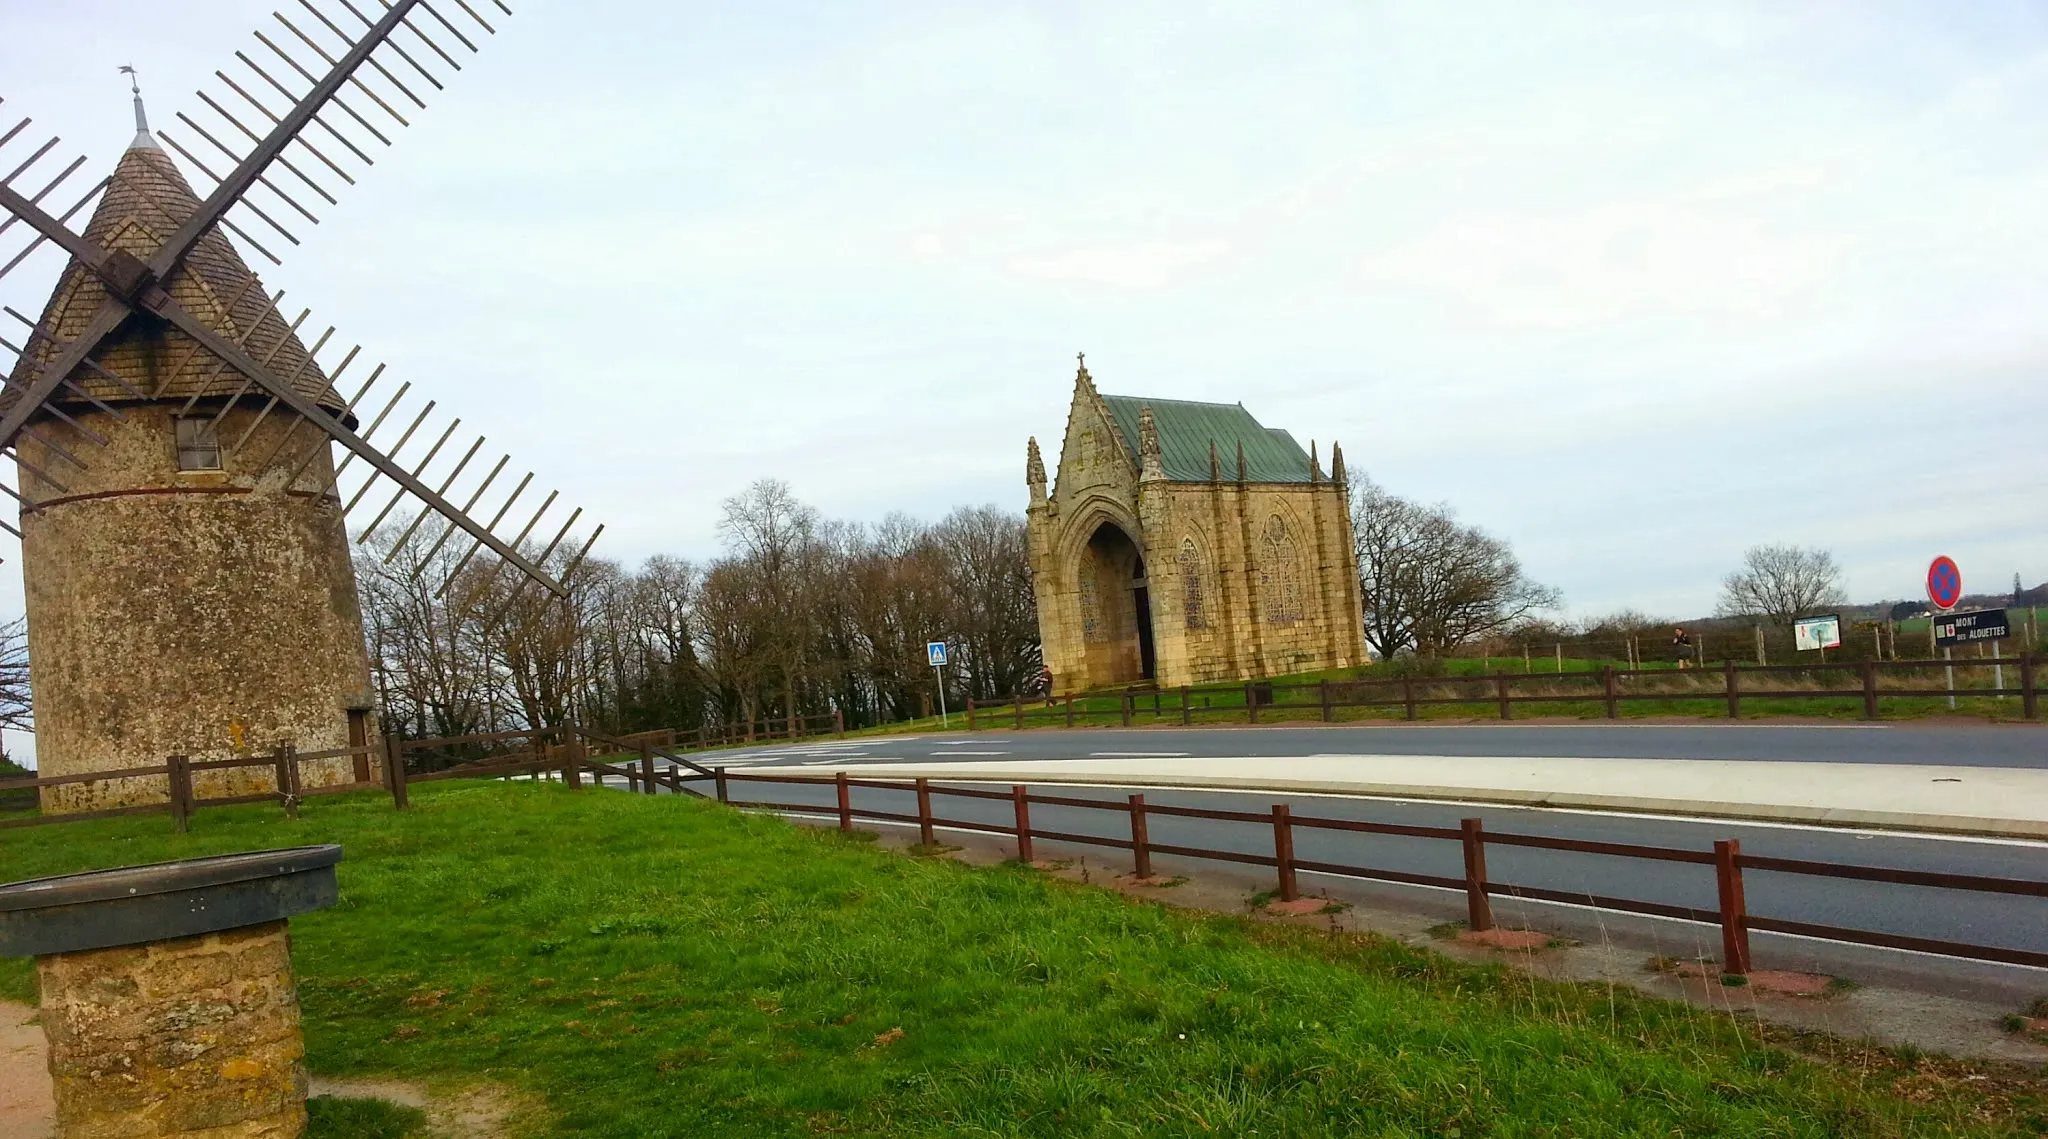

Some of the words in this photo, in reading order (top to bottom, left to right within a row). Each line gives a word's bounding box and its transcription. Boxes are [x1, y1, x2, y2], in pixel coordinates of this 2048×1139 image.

[1955, 616, 1977, 627] MONT
[1957, 633, 1966, 641] DES
[1969, 626, 2005, 639] ALOUETTES
